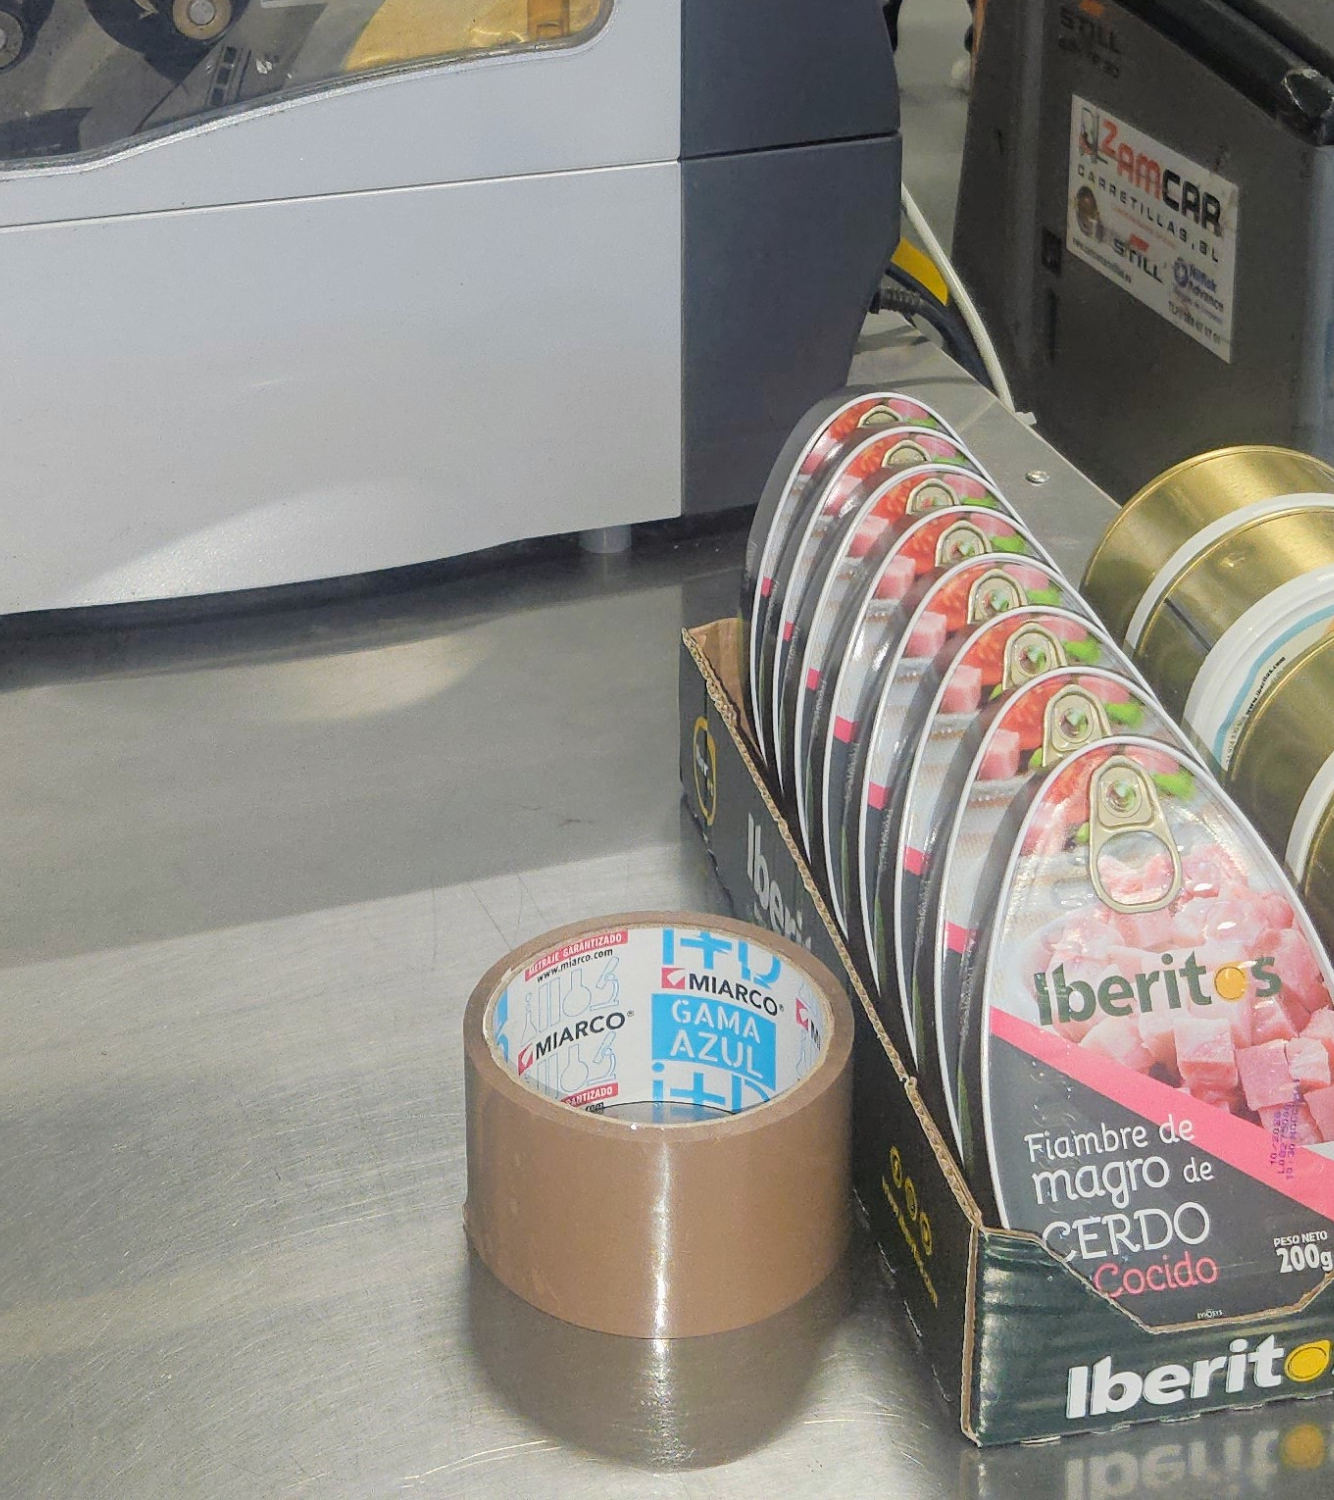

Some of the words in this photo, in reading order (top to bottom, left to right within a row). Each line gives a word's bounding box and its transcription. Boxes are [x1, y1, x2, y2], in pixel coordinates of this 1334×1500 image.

[1101, 119, 1223, 238] ZAMCAR
[1113, 238, 1164, 285] STILL
[528, 950, 559, 975] METRAJE
[562, 933, 622, 958] GARANTIZADO
[536, 948, 613, 983] www.miarco.com
[1033, 950, 1282, 1027] Iberitos
[671, 999, 761, 1044] GAMA
[669, 1029, 763, 1080] AZUL
[1024, 1122, 1148, 1163] Fiambre
[1159, 1114, 1195, 1144] de
[1032, 1156, 1170, 1209] magro
[1183, 1157, 1215, 1183] de
[1042, 1201, 1210, 1262] CERDO
[1273, 1233, 1300, 1248] PESO
[1301, 1230, 1328, 1245] NETO
[1094, 1250, 1218, 1298] Cocido
[1276, 1243, 1333, 1274] 200g
